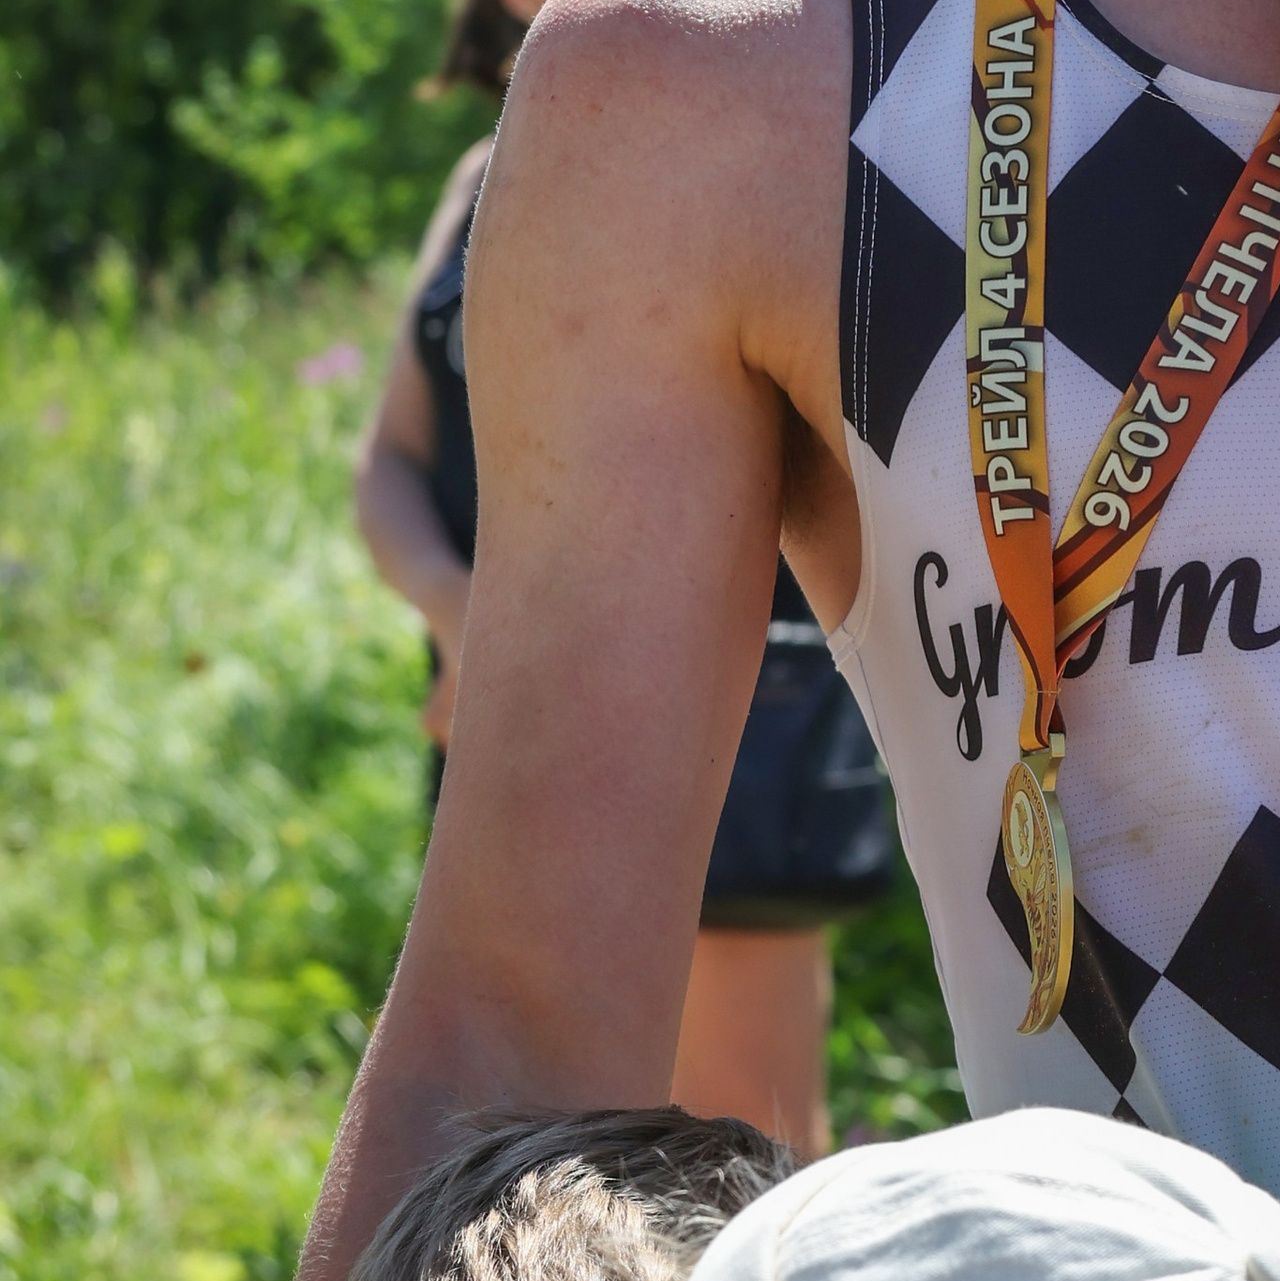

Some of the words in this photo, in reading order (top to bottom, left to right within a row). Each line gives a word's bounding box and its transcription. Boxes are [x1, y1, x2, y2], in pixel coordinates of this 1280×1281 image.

[979, 15, 1036, 259] СЕЗОНА
[980, 272, 1027, 310] 4
[971, 326, 1036, 538] ТРЕЙЛ
[1083, 381, 1190, 533] 2026
